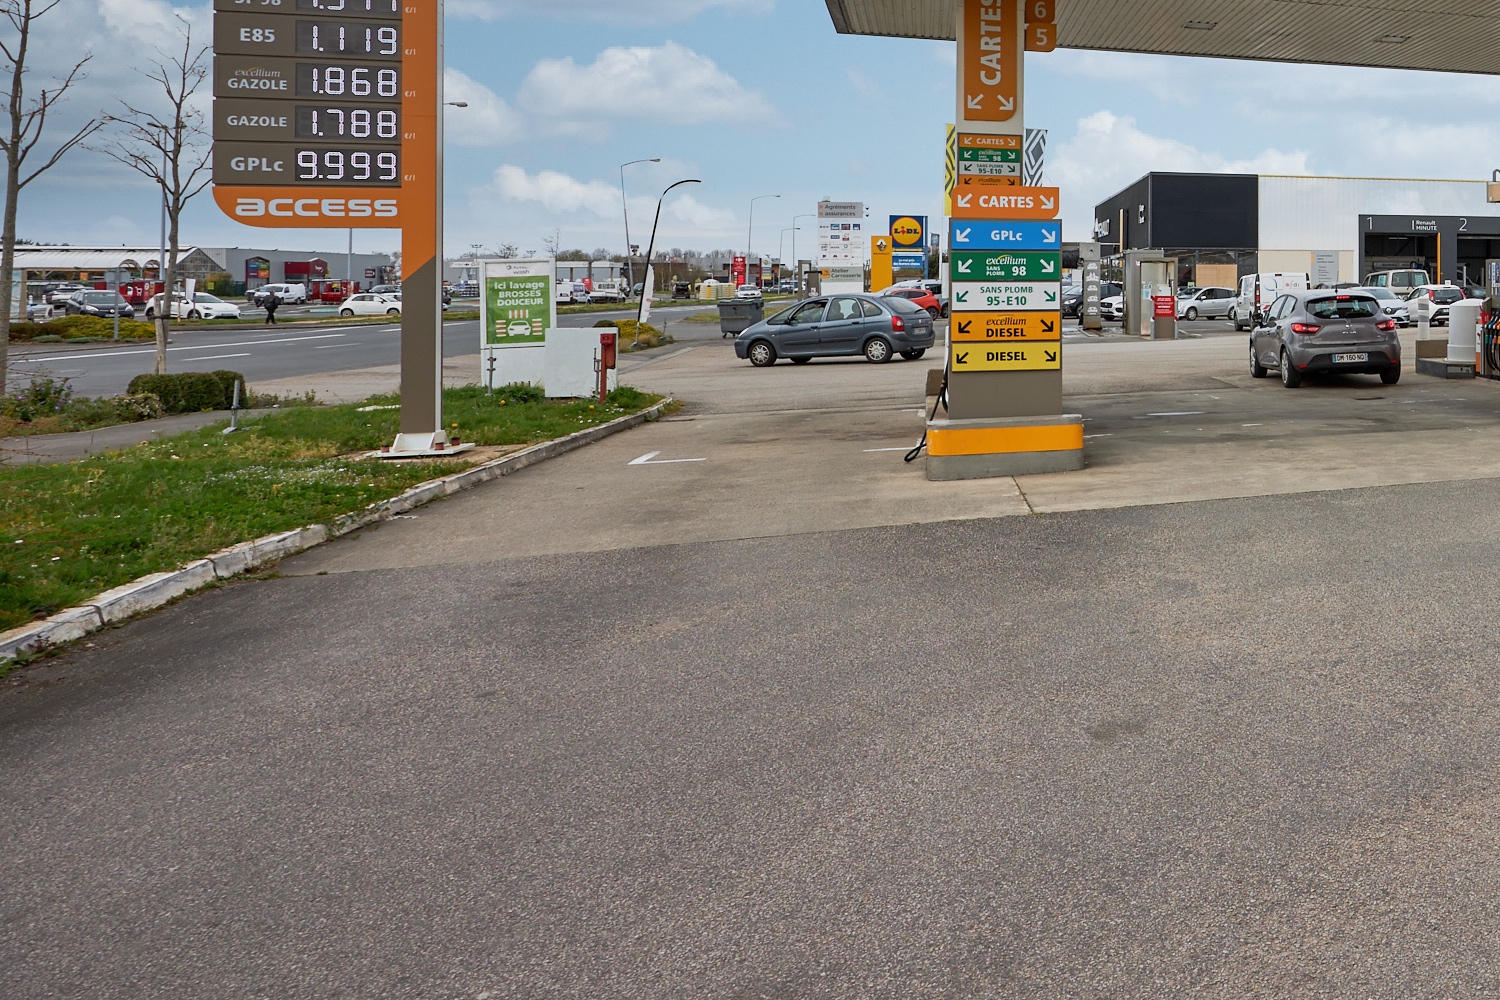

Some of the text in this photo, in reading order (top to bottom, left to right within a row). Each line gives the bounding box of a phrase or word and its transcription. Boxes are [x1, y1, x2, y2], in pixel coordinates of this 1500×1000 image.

[1034, 1, 1047, 18] 6
[239, 28, 276, 43] E85
[312, 25, 397, 55] 1.119
[1035, 28, 1047, 45] 5
[235, 67, 281, 78] excellium
[227, 78, 288, 90] GAZOLE
[312, 67, 398, 97] 1.868
[226, 115, 287, 127] GAZOLE
[312, 108, 397, 138] 1.788
[230, 157, 284, 172] GPLc
[297, 150, 397, 180] 9.999
[978, 195, 1034, 208] CARTES
[1366, 216, 1373, 230] 1
[1458, 218, 1467, 231] 2
[990, 230, 1023, 241] GPLc
[985, 255, 1027, 265] excellium
[1011, 265, 1027, 276] 98
[509, 281, 545, 290] lavage
[498, 290, 542, 298] BROSSES
[497, 298, 544, 306] DOUCEUR
[986, 316, 1027, 326] excellium
[986, 327, 1026, 337] DIESEL
[986, 351, 1027, 361] DIESEL
